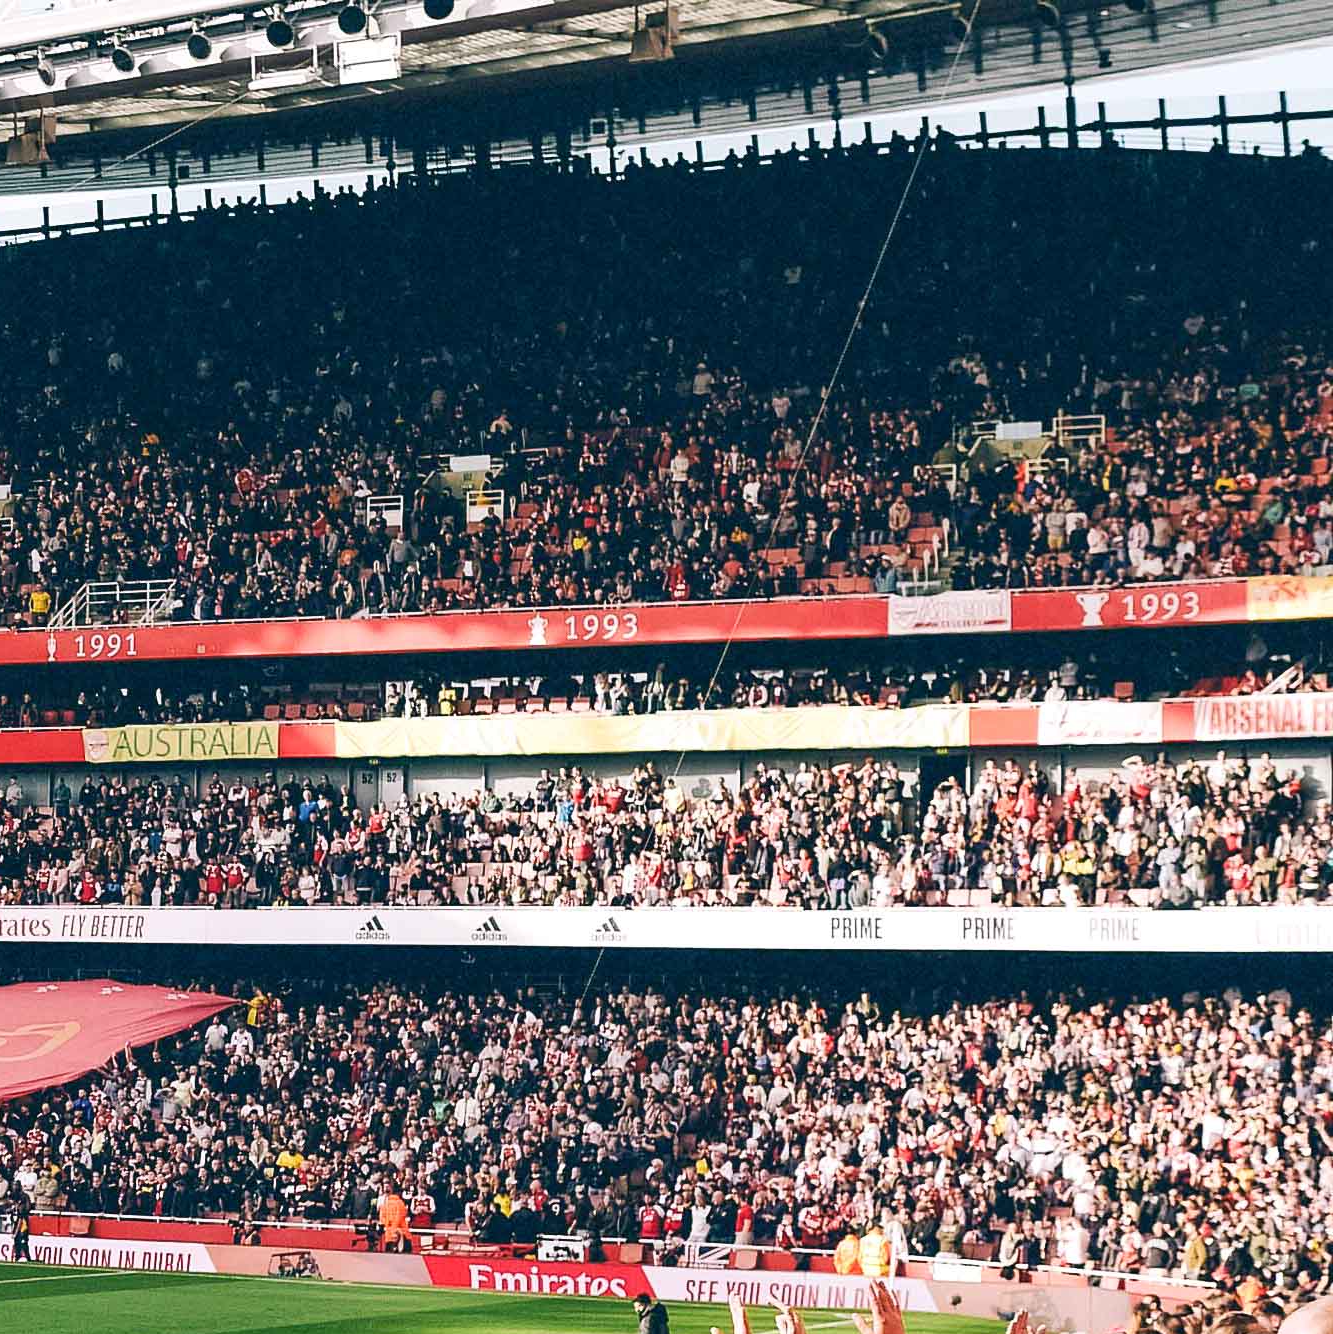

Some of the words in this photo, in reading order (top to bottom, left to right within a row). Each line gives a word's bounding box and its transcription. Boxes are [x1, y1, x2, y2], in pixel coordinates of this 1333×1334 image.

[1121, 592, 1200, 622] 1993
[565, 614, 639, 641] 1993
[74, 633, 137, 657] 1991
[1209, 700, 1306, 734] ARSENAL
[112, 725, 275, 760] AUSTRALIA
[361, 772, 373, 785] 52
[386, 772, 397, 783] 52
[61, 914, 87, 937] FLY
[90, 914, 145, 938] BETTER
[355, 929, 391, 941] adidas
[471, 929, 508, 942] adidas
[830, 917, 883, 940] PRIME
[962, 917, 1015, 941] PRIME
[1088, 917, 1141, 942] PRIME
[34, 1246, 63, 1264] YOU
[70, 1248, 111, 1267] SOON
[119, 1250, 133, 1270] IN
[469, 1265, 626, 1298] Emirates
[685, 1279, 717, 1302] SEE
[769, 1283, 817, 1308] SOON
[826, 1286, 846, 1309] IN
